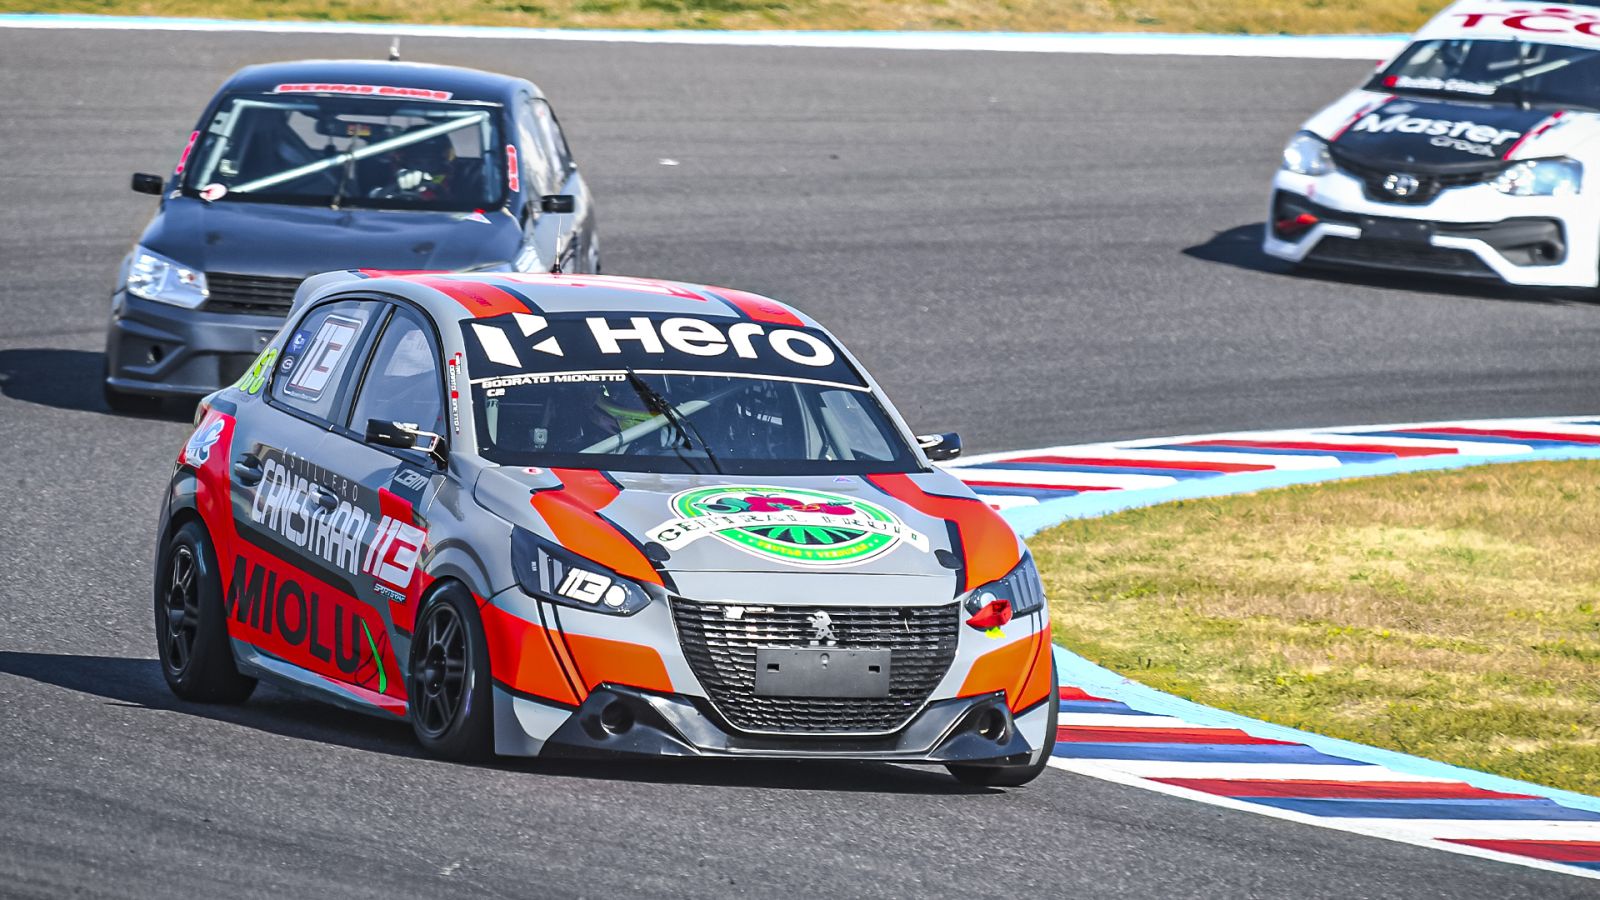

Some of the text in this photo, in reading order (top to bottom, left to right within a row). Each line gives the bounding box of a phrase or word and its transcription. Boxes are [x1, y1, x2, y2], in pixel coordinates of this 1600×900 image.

[1353, 113, 1521, 145] Master
[586, 314, 835, 367] Hero
[481, 373, 627, 389] BODRATO MIONETTO
[362, 514, 428, 589] 113
[557, 567, 613, 605] 113
